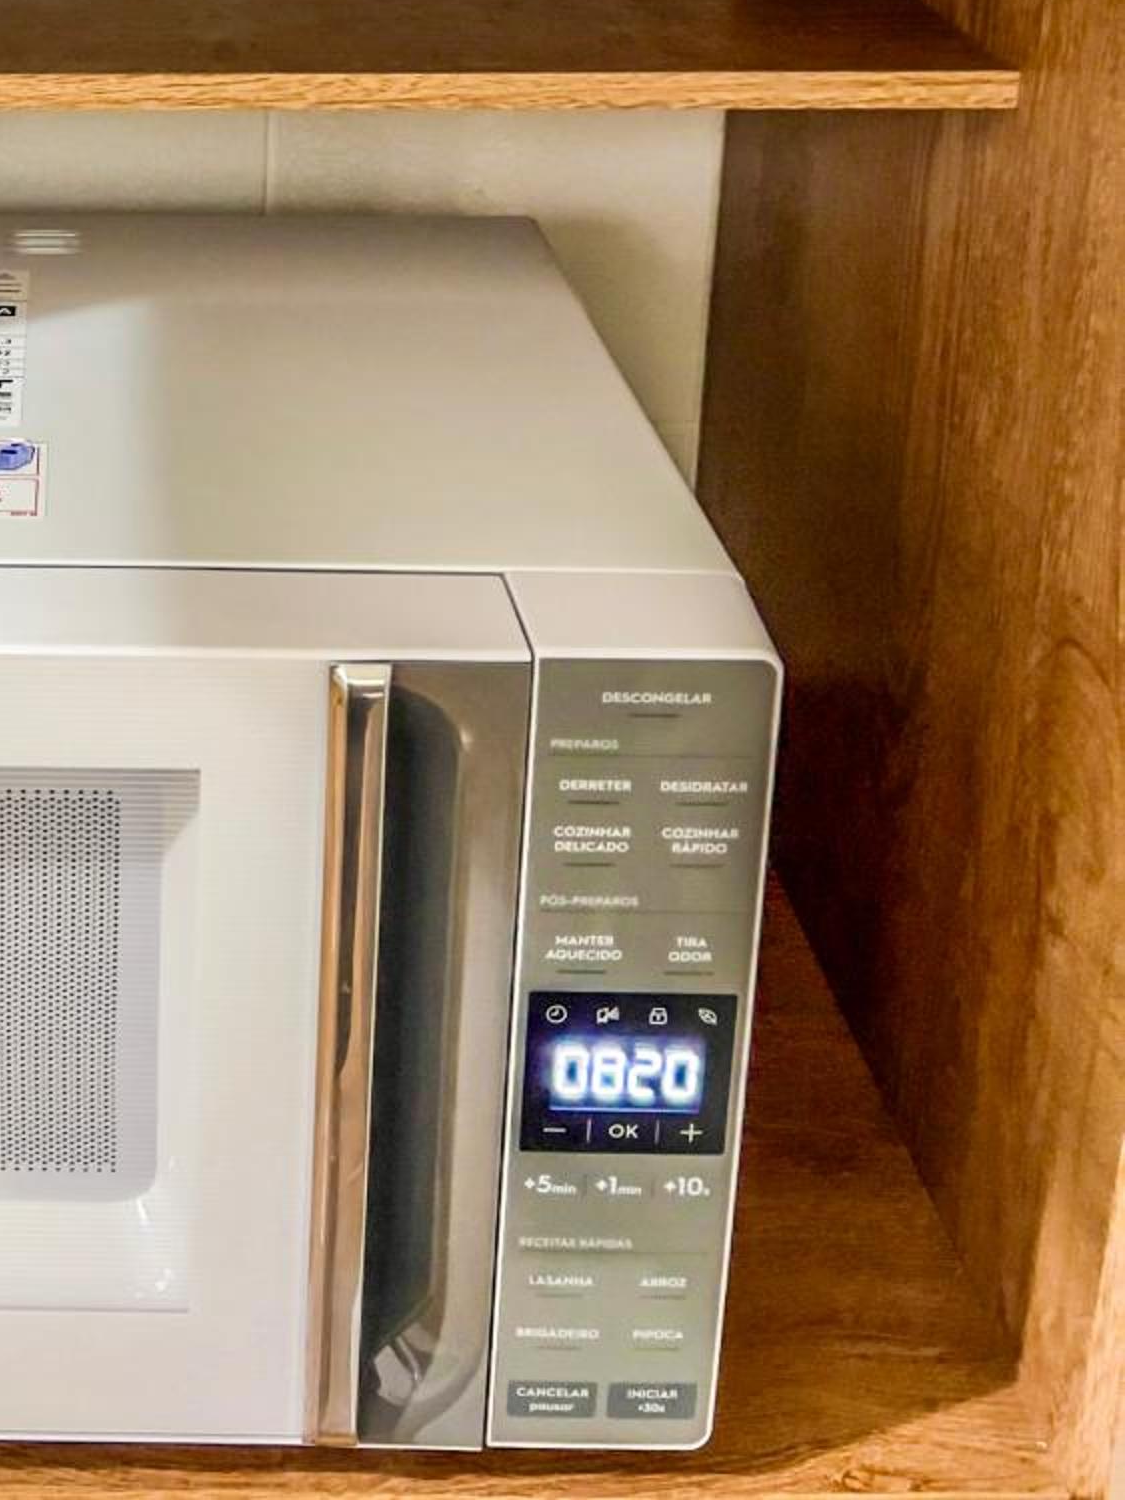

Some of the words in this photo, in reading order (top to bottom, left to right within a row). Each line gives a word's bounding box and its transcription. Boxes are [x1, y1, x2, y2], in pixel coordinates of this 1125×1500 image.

[602, 691, 712, 704] DESCONGELAR
[550, 738, 620, 750] PREPAROS
[559, 779, 632, 792] DERRETER
[660, 780, 748, 793] DESIDRATAR
[553, 826, 632, 839] COZINHAR
[662, 827, 740, 840] COZINHAR
[554, 841, 629, 853] DELICADO
[555, 935, 614, 947] MANTER
[676, 936, 708, 948] TIRA
[545, 950, 623, 962] AQUECIDO
[668, 951, 712, 963] ODOR
[552, 1041, 701, 1106] 0820
[608, 1124, 639, 1139] OK
[528, 1275, 594, 1286] LASANHA
[640, 1277, 687, 1288] ARROZ
[515, 1327, 600, 1339] BRIGADEIRO
[633, 1329, 683, 1340] PIPOCA
[516, 1387, 589, 1398] CANCELAR
[627, 1389, 677, 1400] INICIAR
